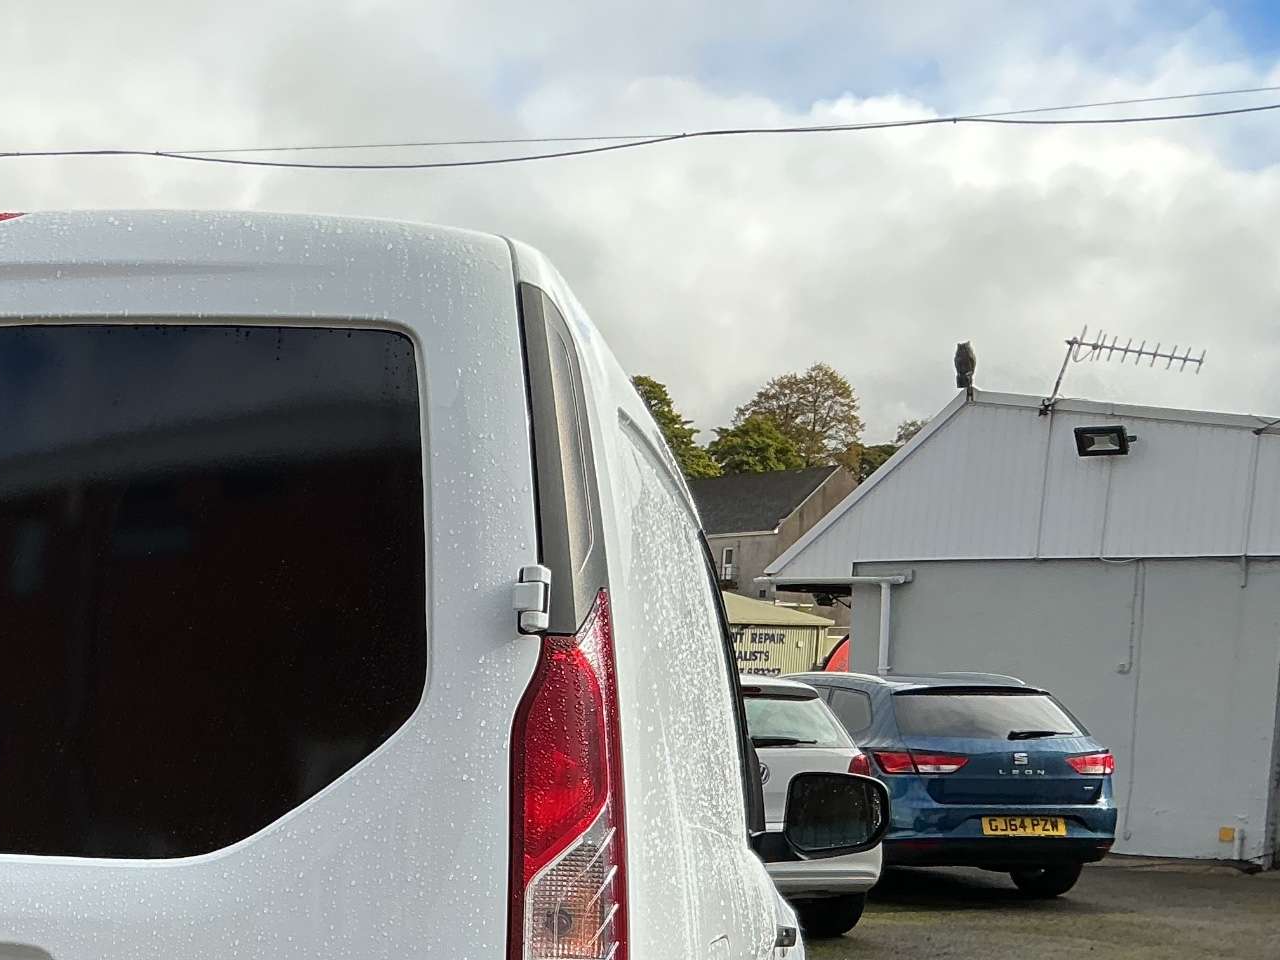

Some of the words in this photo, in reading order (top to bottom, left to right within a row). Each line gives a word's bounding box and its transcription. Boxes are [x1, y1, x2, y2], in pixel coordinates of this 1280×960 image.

[751, 633, 785, 645] REPAIR
[988, 818, 1027, 832] GJ64
[1031, 818, 1059, 832] PZW
